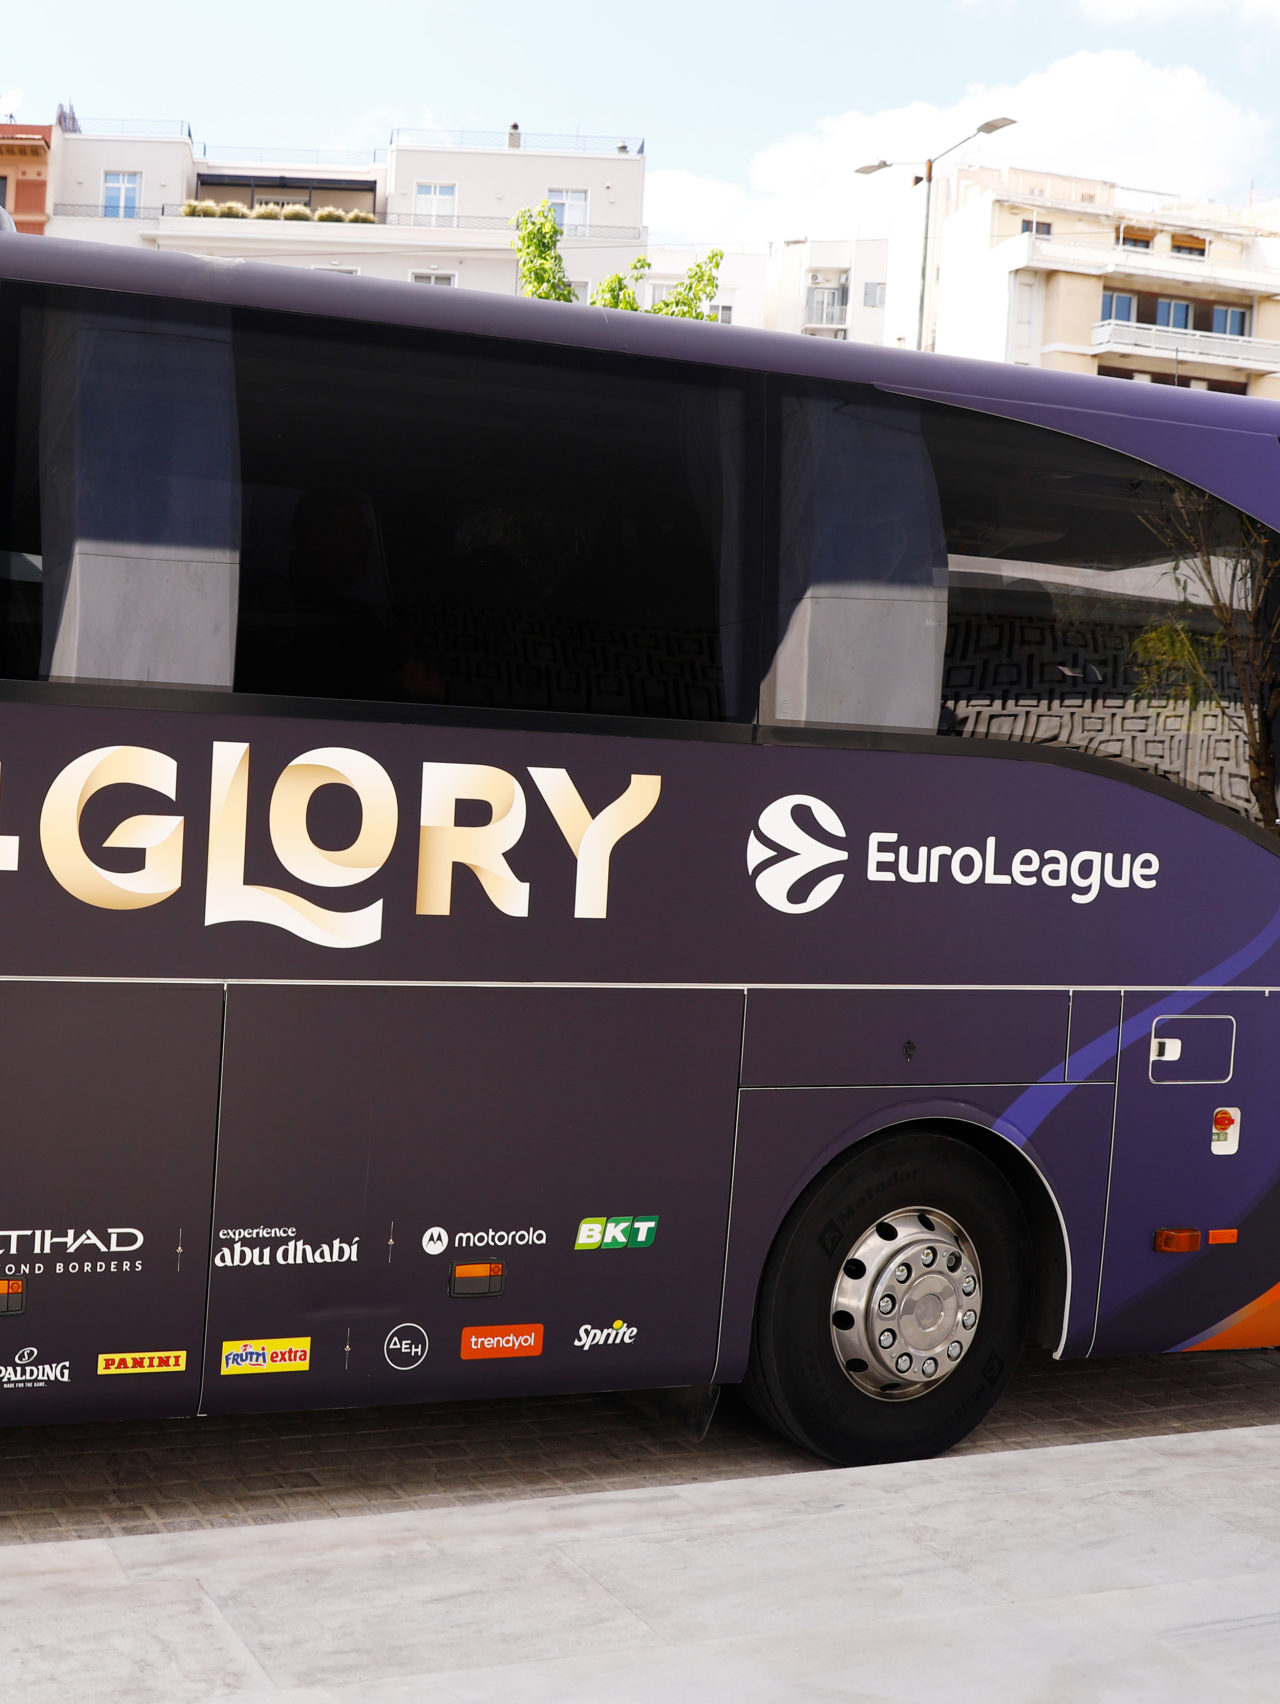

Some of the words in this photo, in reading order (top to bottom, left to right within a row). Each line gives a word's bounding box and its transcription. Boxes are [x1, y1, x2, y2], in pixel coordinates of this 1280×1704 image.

[867, 832, 1160, 904] EuroLeague
[455, 1227, 547, 1248] motorola
[576, 1221, 656, 1244] BKT
[214, 1241, 271, 1268] abu
[55, 1260, 143, 1274] BORDERS
[470, 1332, 535, 1350] trendyol
[574, 1320, 638, 1350] Sprite
[103, 1355, 181, 1370] PANINI
[270, 1347, 308, 1363] extra
